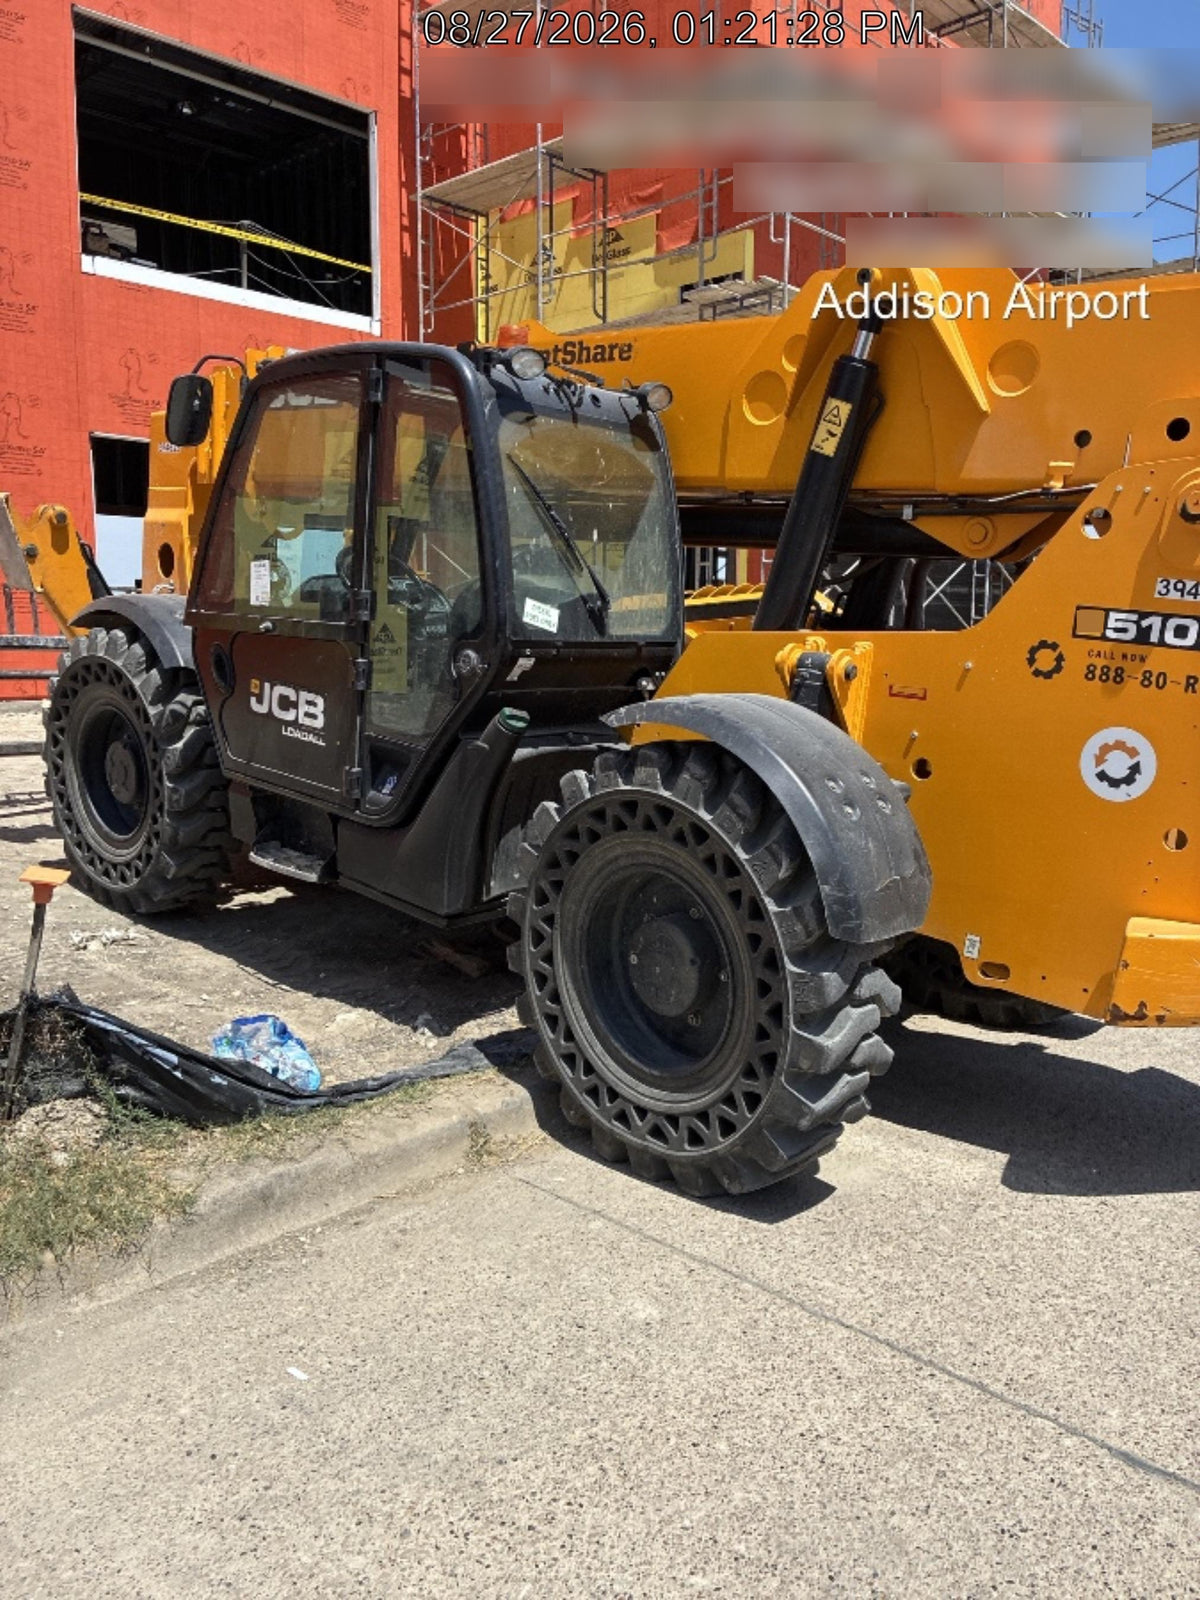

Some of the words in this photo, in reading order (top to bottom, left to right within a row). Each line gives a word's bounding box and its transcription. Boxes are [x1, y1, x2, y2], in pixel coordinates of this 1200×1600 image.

[540, 339, 633, 365] ntShare
[1157, 578, 1200, 600] 394
[1105, 611, 1200, 647] 510
[1087, 648, 1116, 661] CALL
[1121, 651, 1149, 664] NOW
[1084, 662, 1200, 694] 888-80-R
[250, 681, 326, 730] JCB
[281, 724, 327, 747] LOADALL
